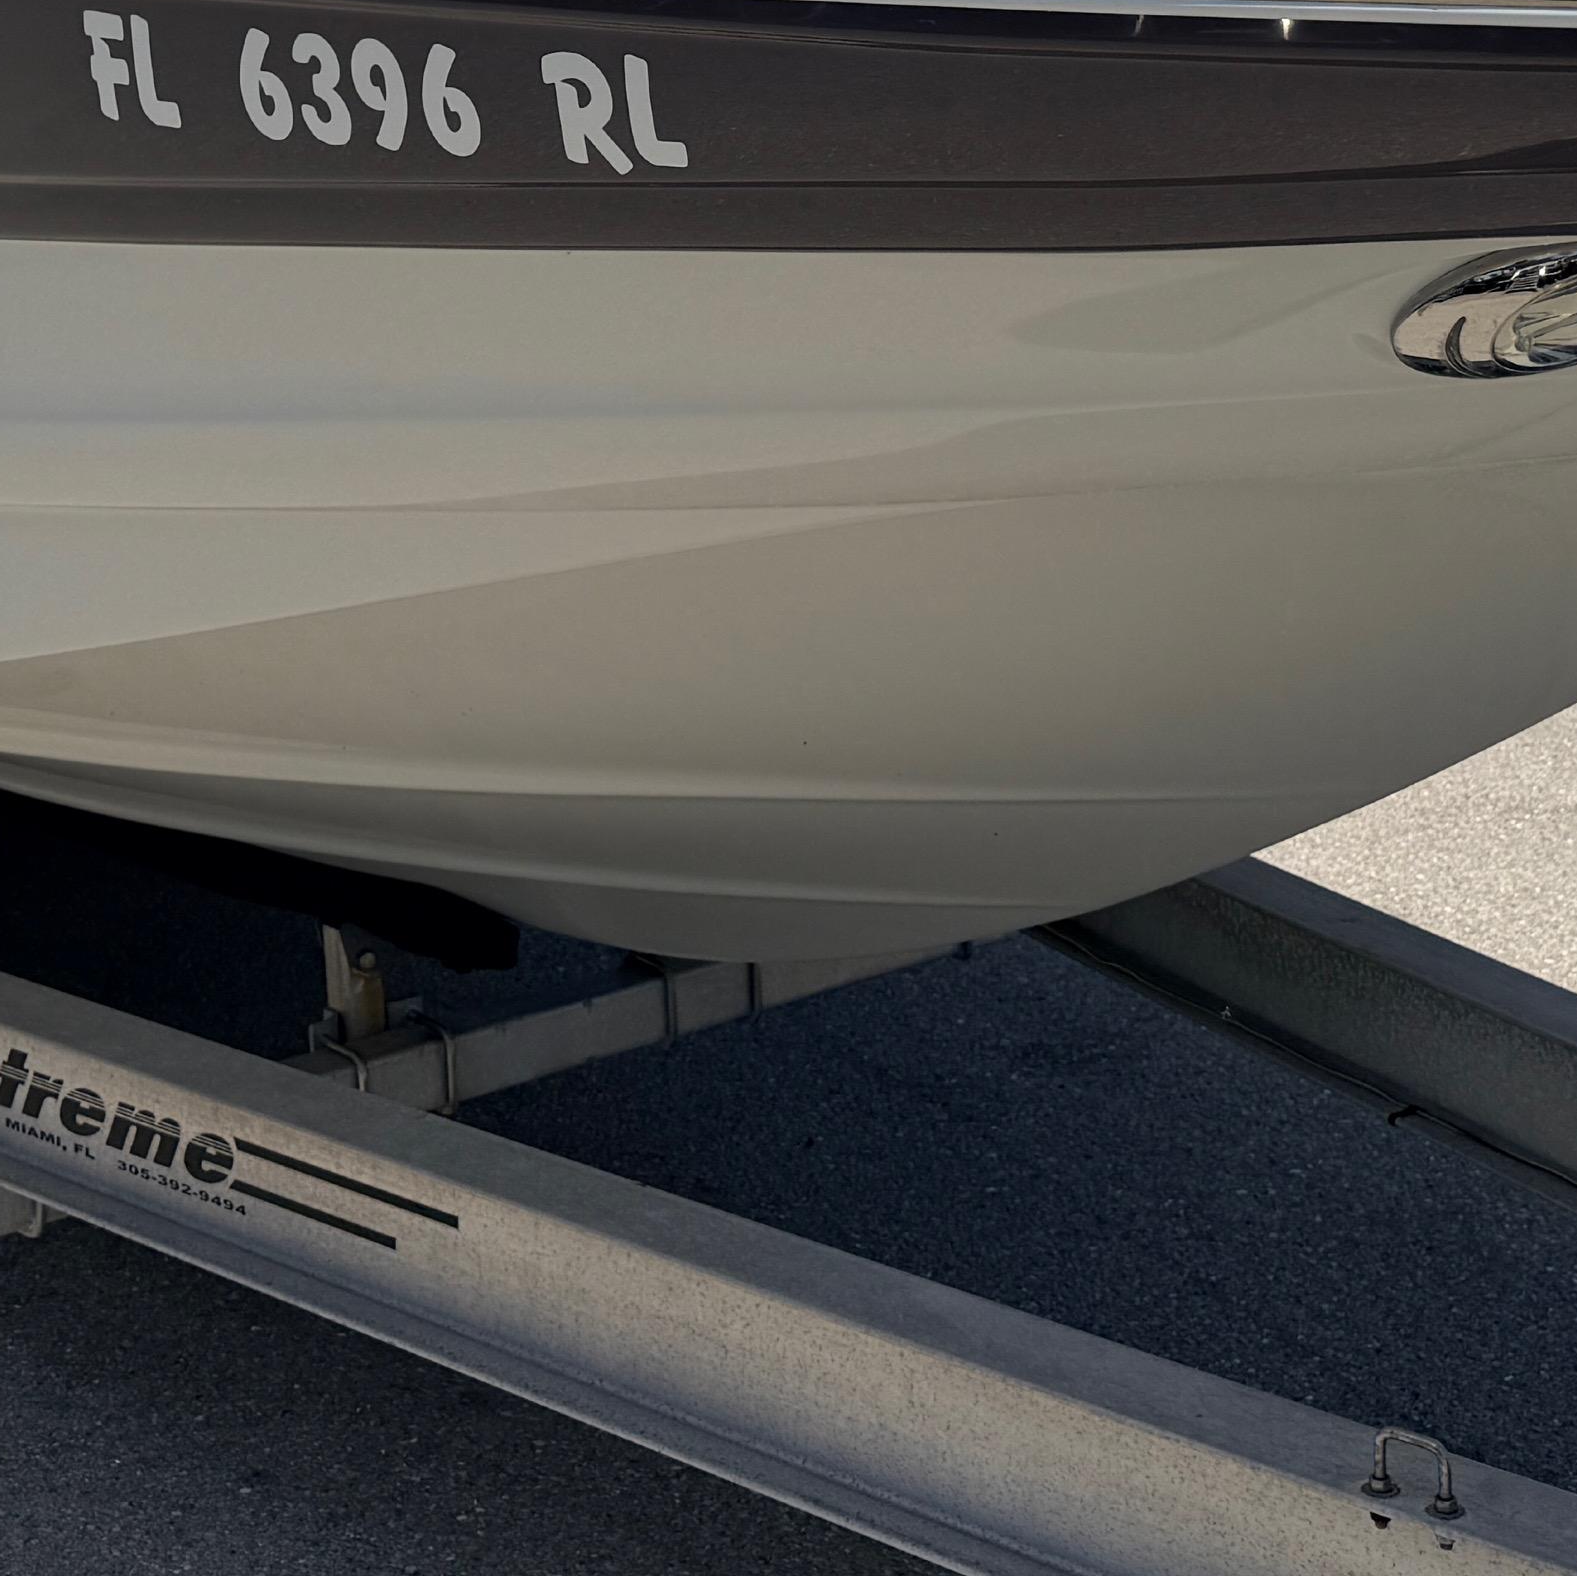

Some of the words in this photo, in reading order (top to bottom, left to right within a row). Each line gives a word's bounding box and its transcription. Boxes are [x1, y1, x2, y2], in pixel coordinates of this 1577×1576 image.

[83, 9, 182, 129] FL
[239, 27, 482, 157] 6396
[540, 50, 689, 176] RL
[74, 1143, 96, 1160] FL
[117, 1159, 247, 1216] 305-392-9494
